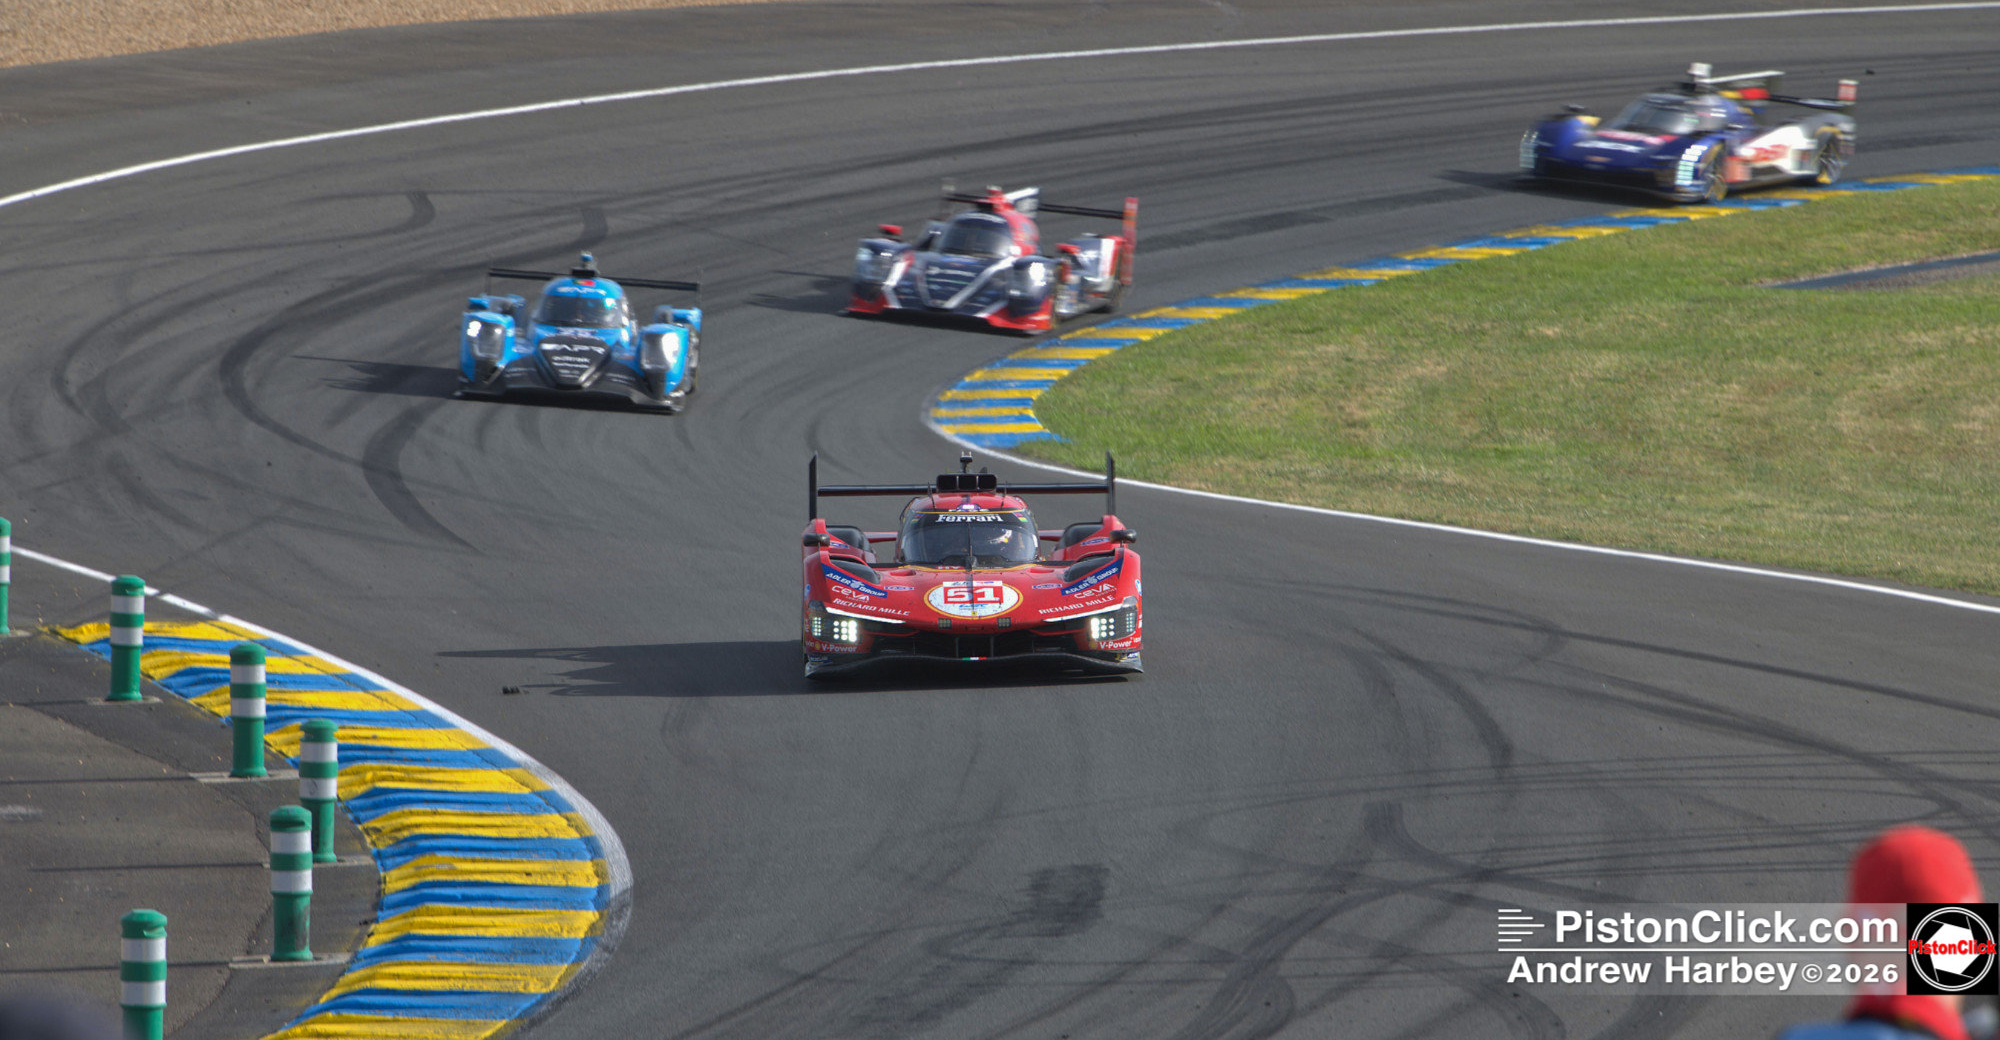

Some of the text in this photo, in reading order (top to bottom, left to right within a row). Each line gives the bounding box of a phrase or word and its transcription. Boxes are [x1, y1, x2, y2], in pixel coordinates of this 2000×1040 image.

[936, 513, 1004, 523] Ferrari
[825, 572, 851, 586] ADLER
[859, 585, 886, 597] GROUP
[1065, 582, 1090, 595] ADLER
[1097, 567, 1119, 581] GROUP
[946, 587, 1001, 602] 51
[833, 598, 877, 612] RICHARD
[878, 607, 911, 616] MILLE
[1038, 595, 1116, 615] RICHARD MILLE
[821, 643, 857, 653] V-Power
[1100, 640, 1133, 650] V-Power
